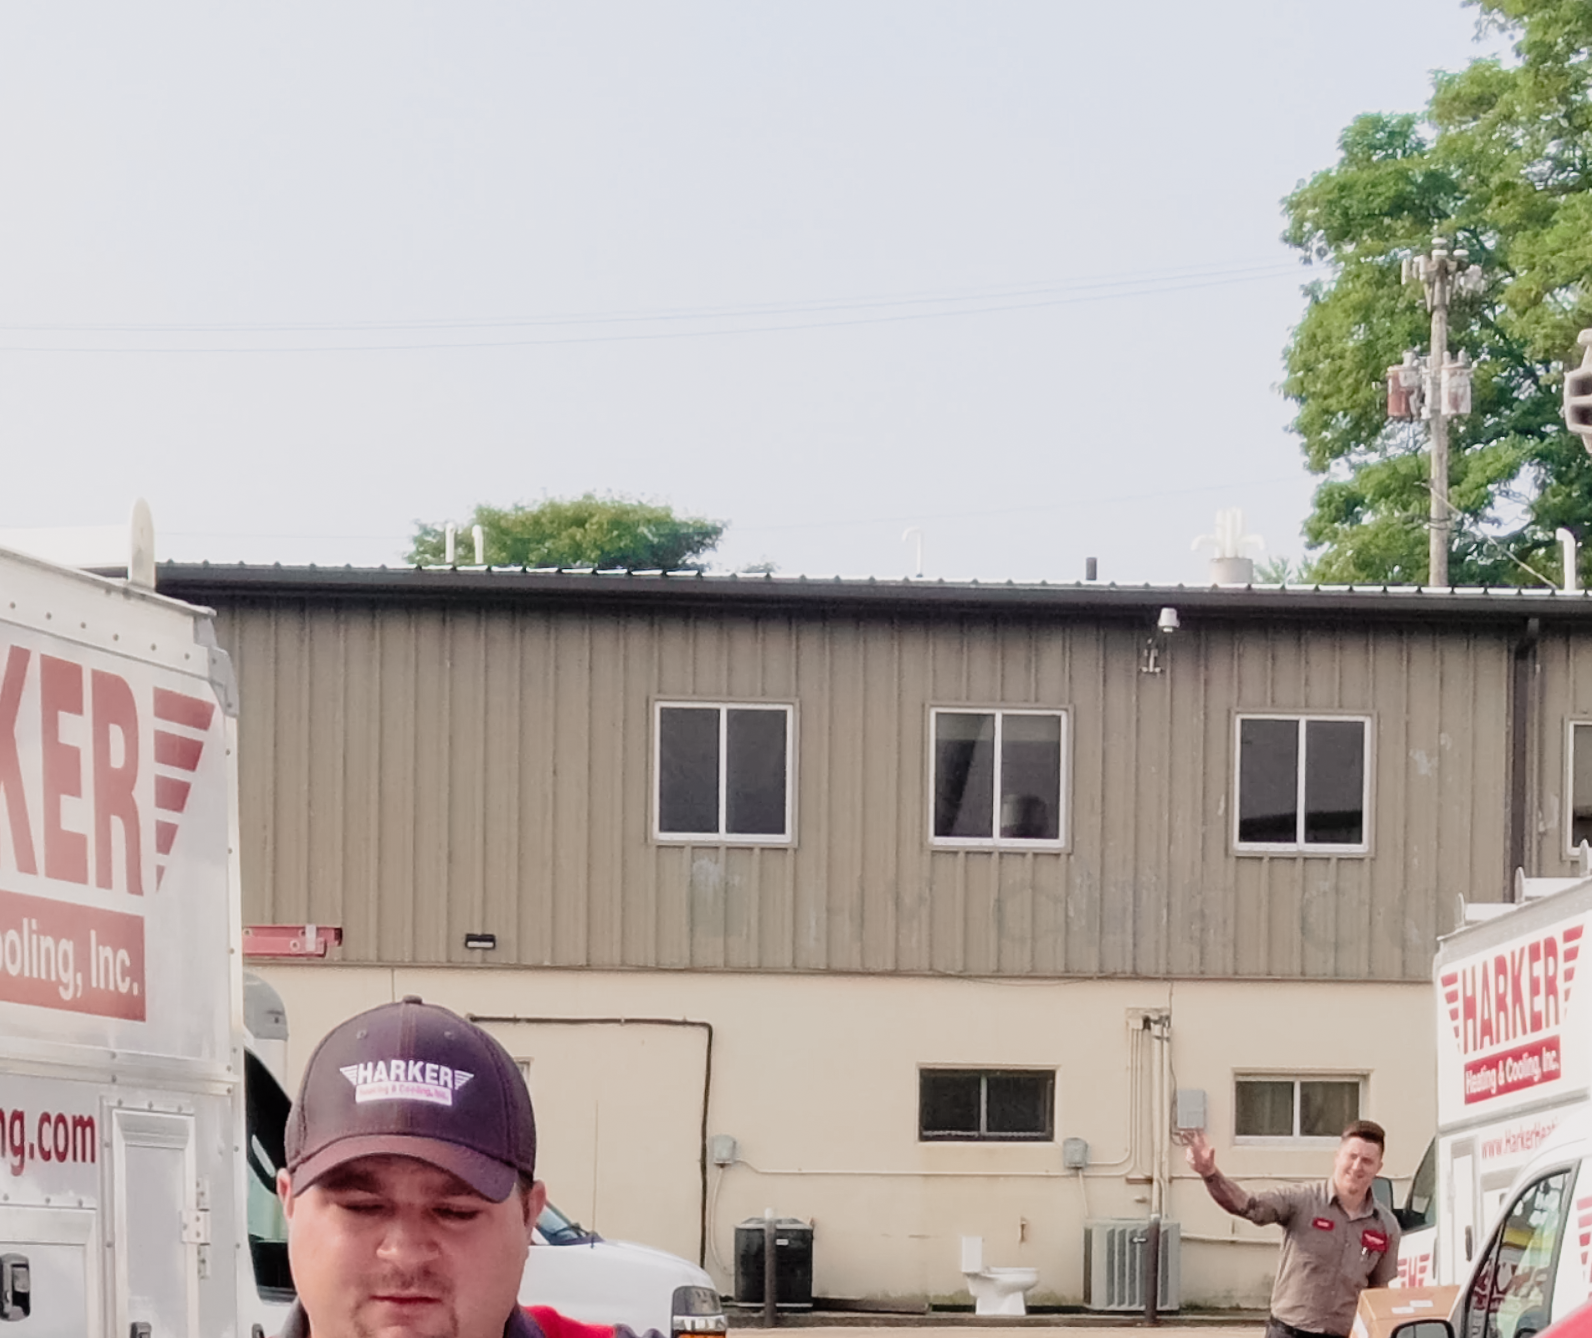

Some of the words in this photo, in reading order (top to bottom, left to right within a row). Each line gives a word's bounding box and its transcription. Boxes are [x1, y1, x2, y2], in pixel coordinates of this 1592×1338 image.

[90, 928, 140, 998] Inc.
[1462, 936, 1560, 1055] HARKER
[357, 1060, 453, 1090] HARKER
[1465, 1065, 1497, 1095] Heating
[1498, 1060, 1505, 1087] &
